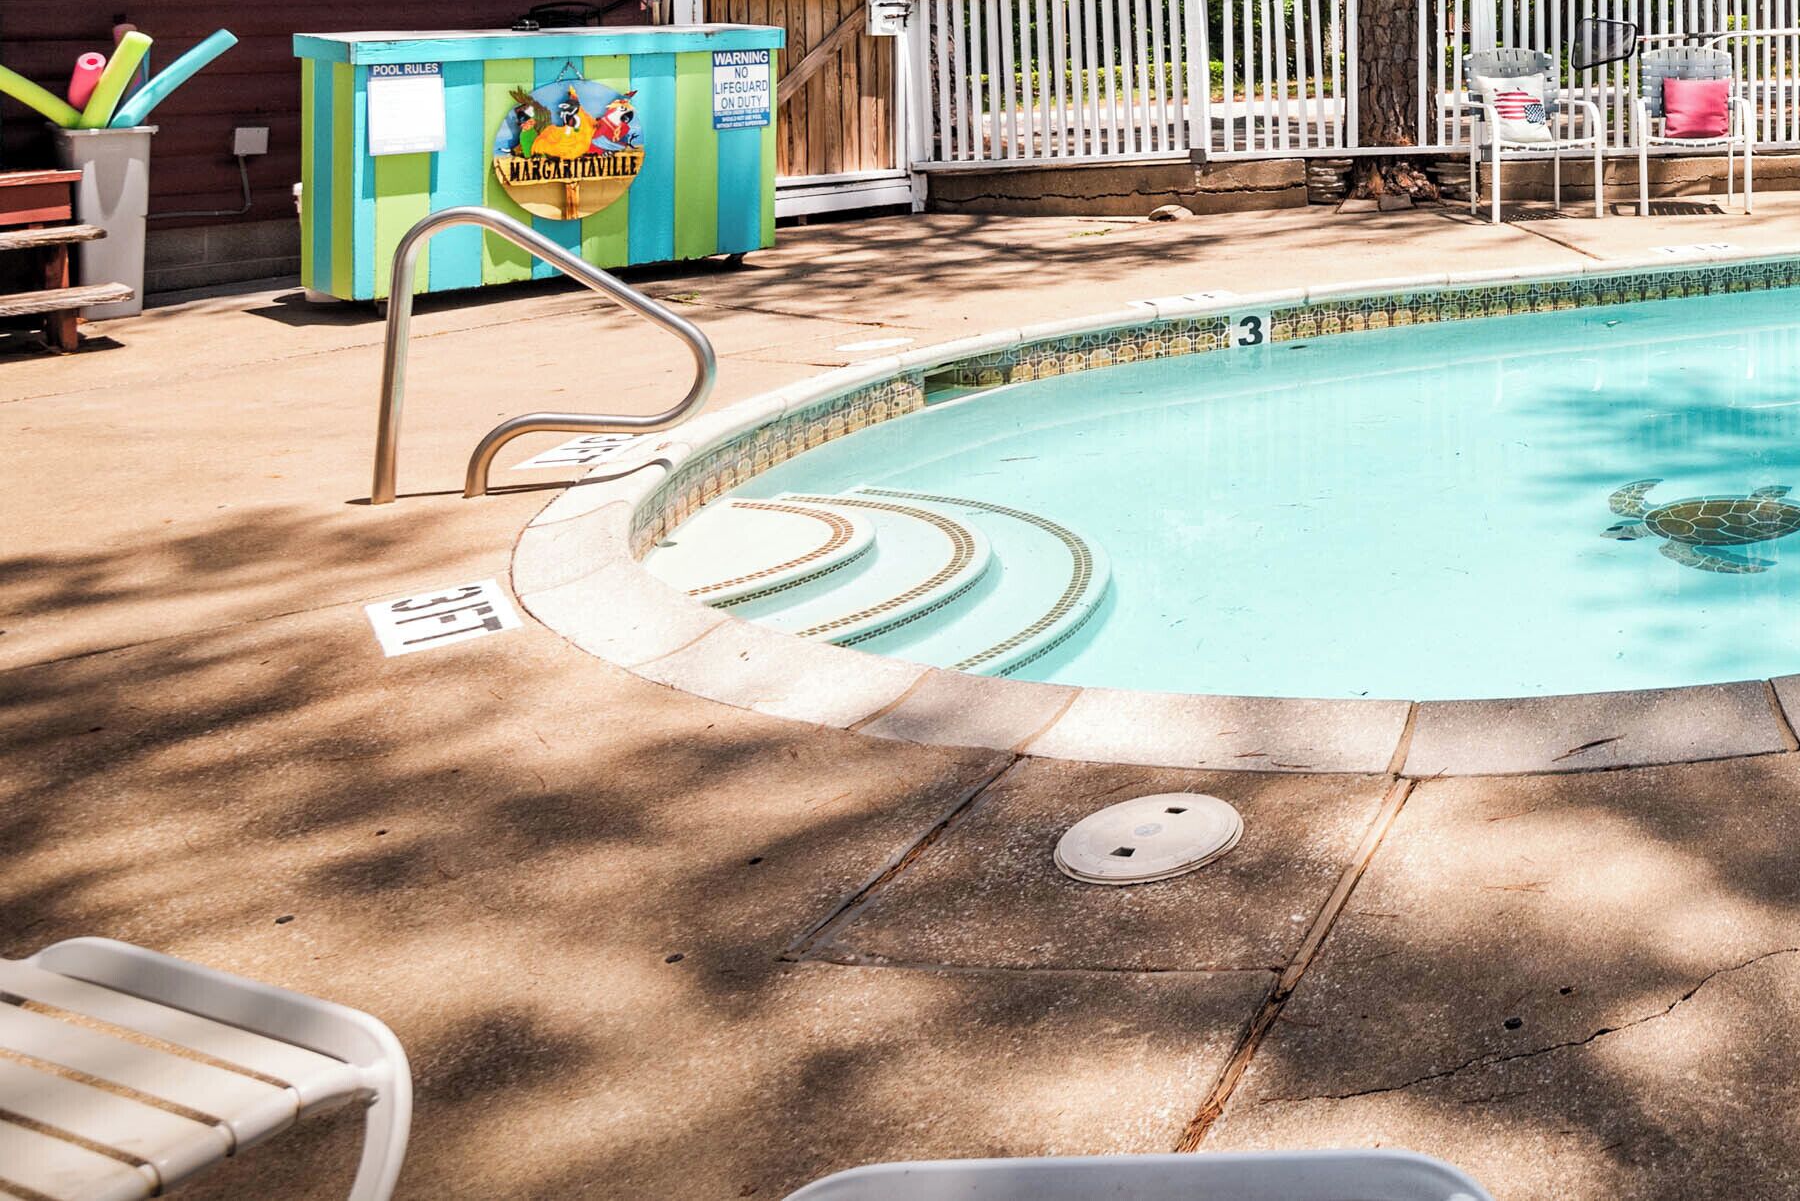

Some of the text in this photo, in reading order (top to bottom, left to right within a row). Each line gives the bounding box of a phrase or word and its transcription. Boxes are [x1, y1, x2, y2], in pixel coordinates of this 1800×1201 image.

[714, 51, 768, 66] WARNING
[373, 63, 439, 75] POOL RULES
[734, 66, 748, 78] NO
[715, 80, 768, 94] LIFEGUARD
[721, 95, 762, 109] ON DUTY
[510, 156, 637, 182] MARGARITAVILLE
[1238, 315, 1263, 346] 3
